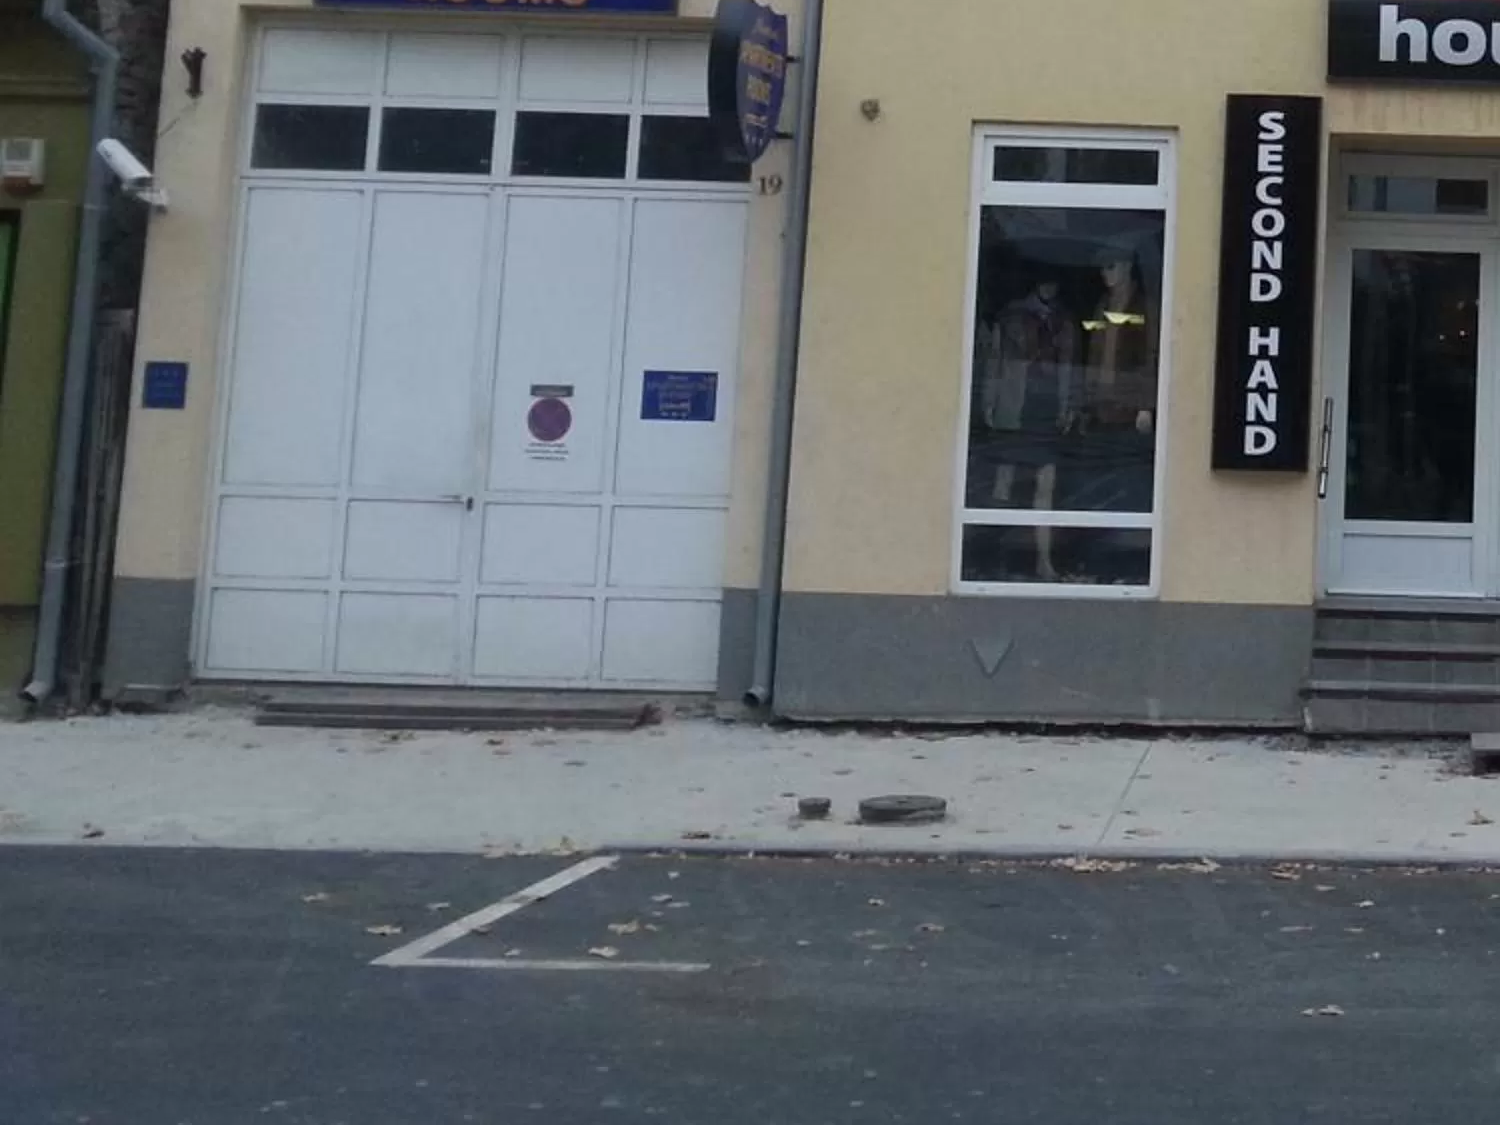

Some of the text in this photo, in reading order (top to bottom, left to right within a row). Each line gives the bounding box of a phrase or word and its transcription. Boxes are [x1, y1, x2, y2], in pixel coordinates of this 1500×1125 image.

[757, 176, 783, 196] 19
[1243, 111, 1287, 456] SECOND HAND
